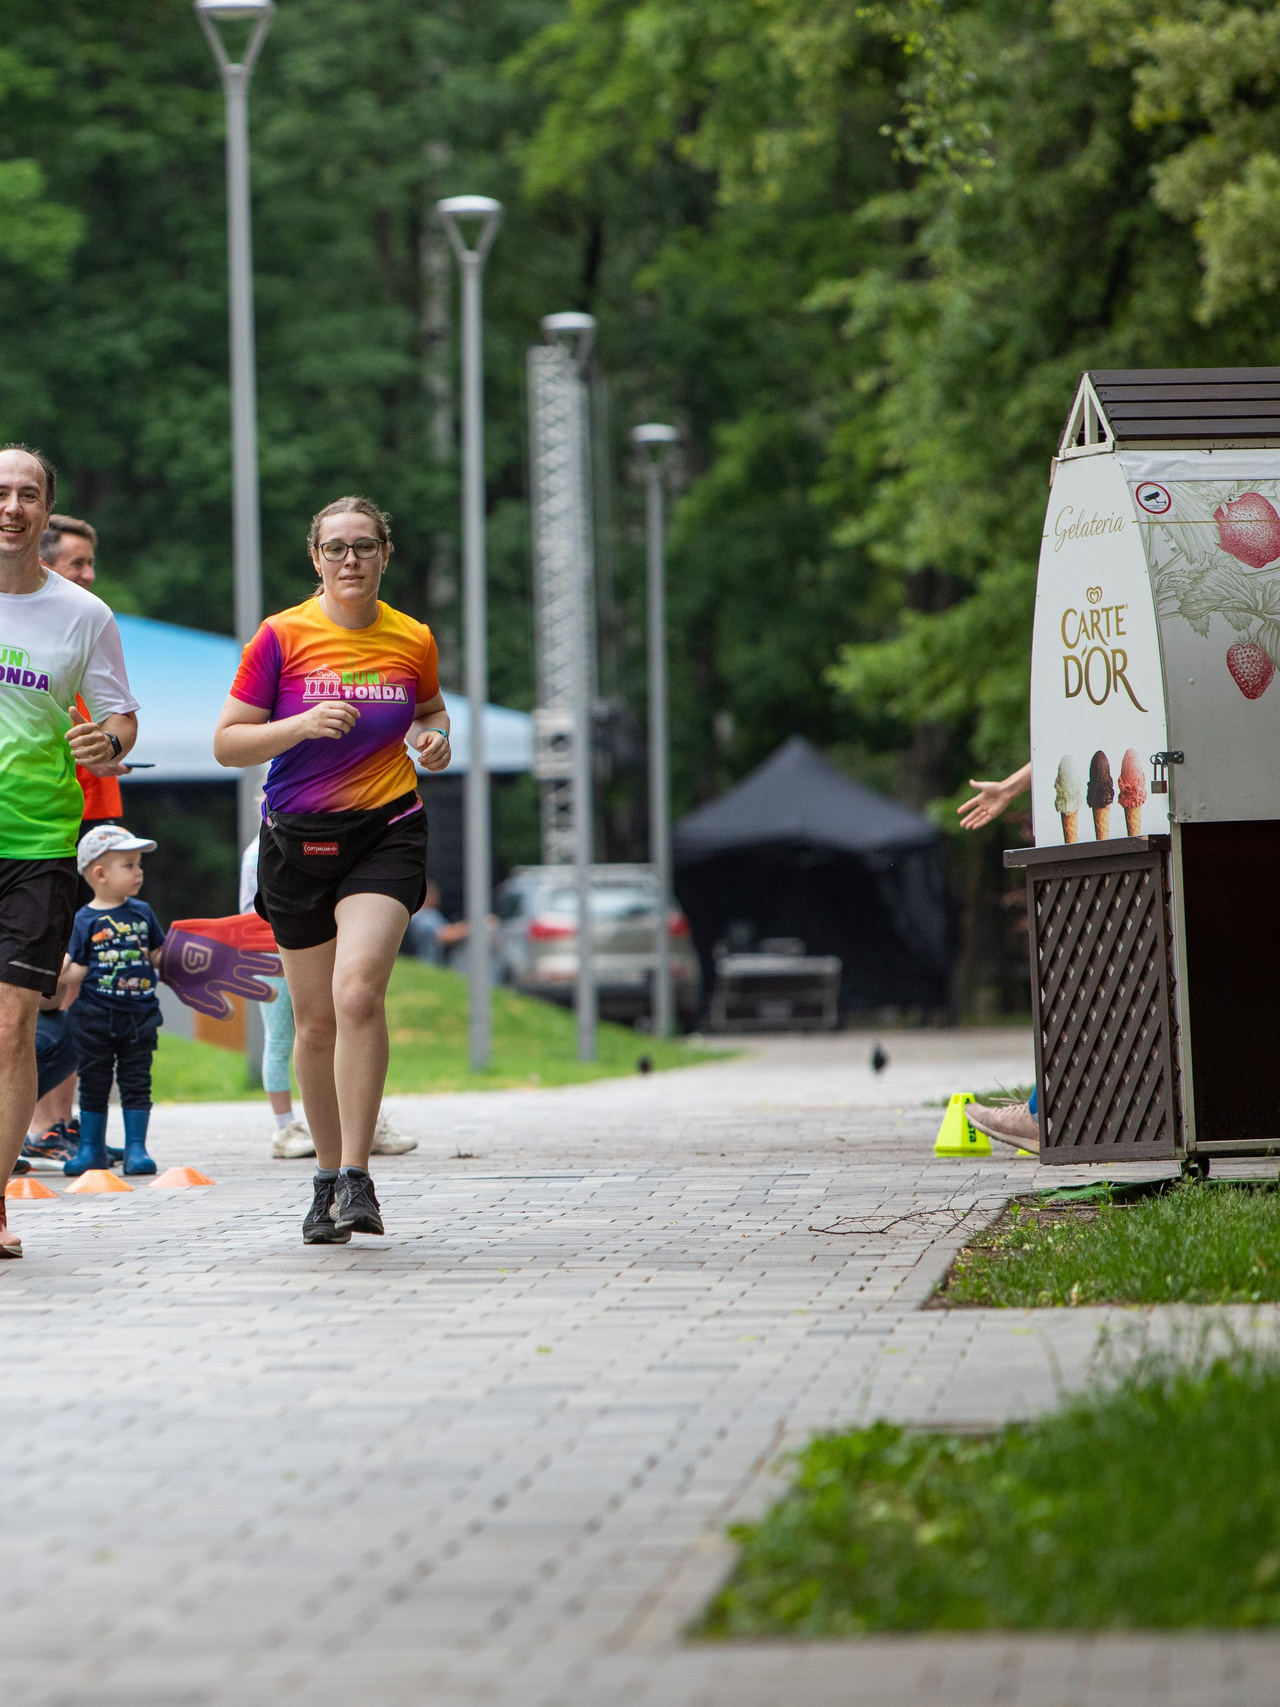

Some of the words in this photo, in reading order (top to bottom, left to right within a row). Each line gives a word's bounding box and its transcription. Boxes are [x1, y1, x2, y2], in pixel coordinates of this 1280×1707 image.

[1054, 505, 1125, 552] Gelateria
[1061, 605, 1127, 649] CARTE
[341, 671, 381, 685] RUN
[341, 685, 406, 701] TONDA
[1062, 644, 1149, 713] D'OR
